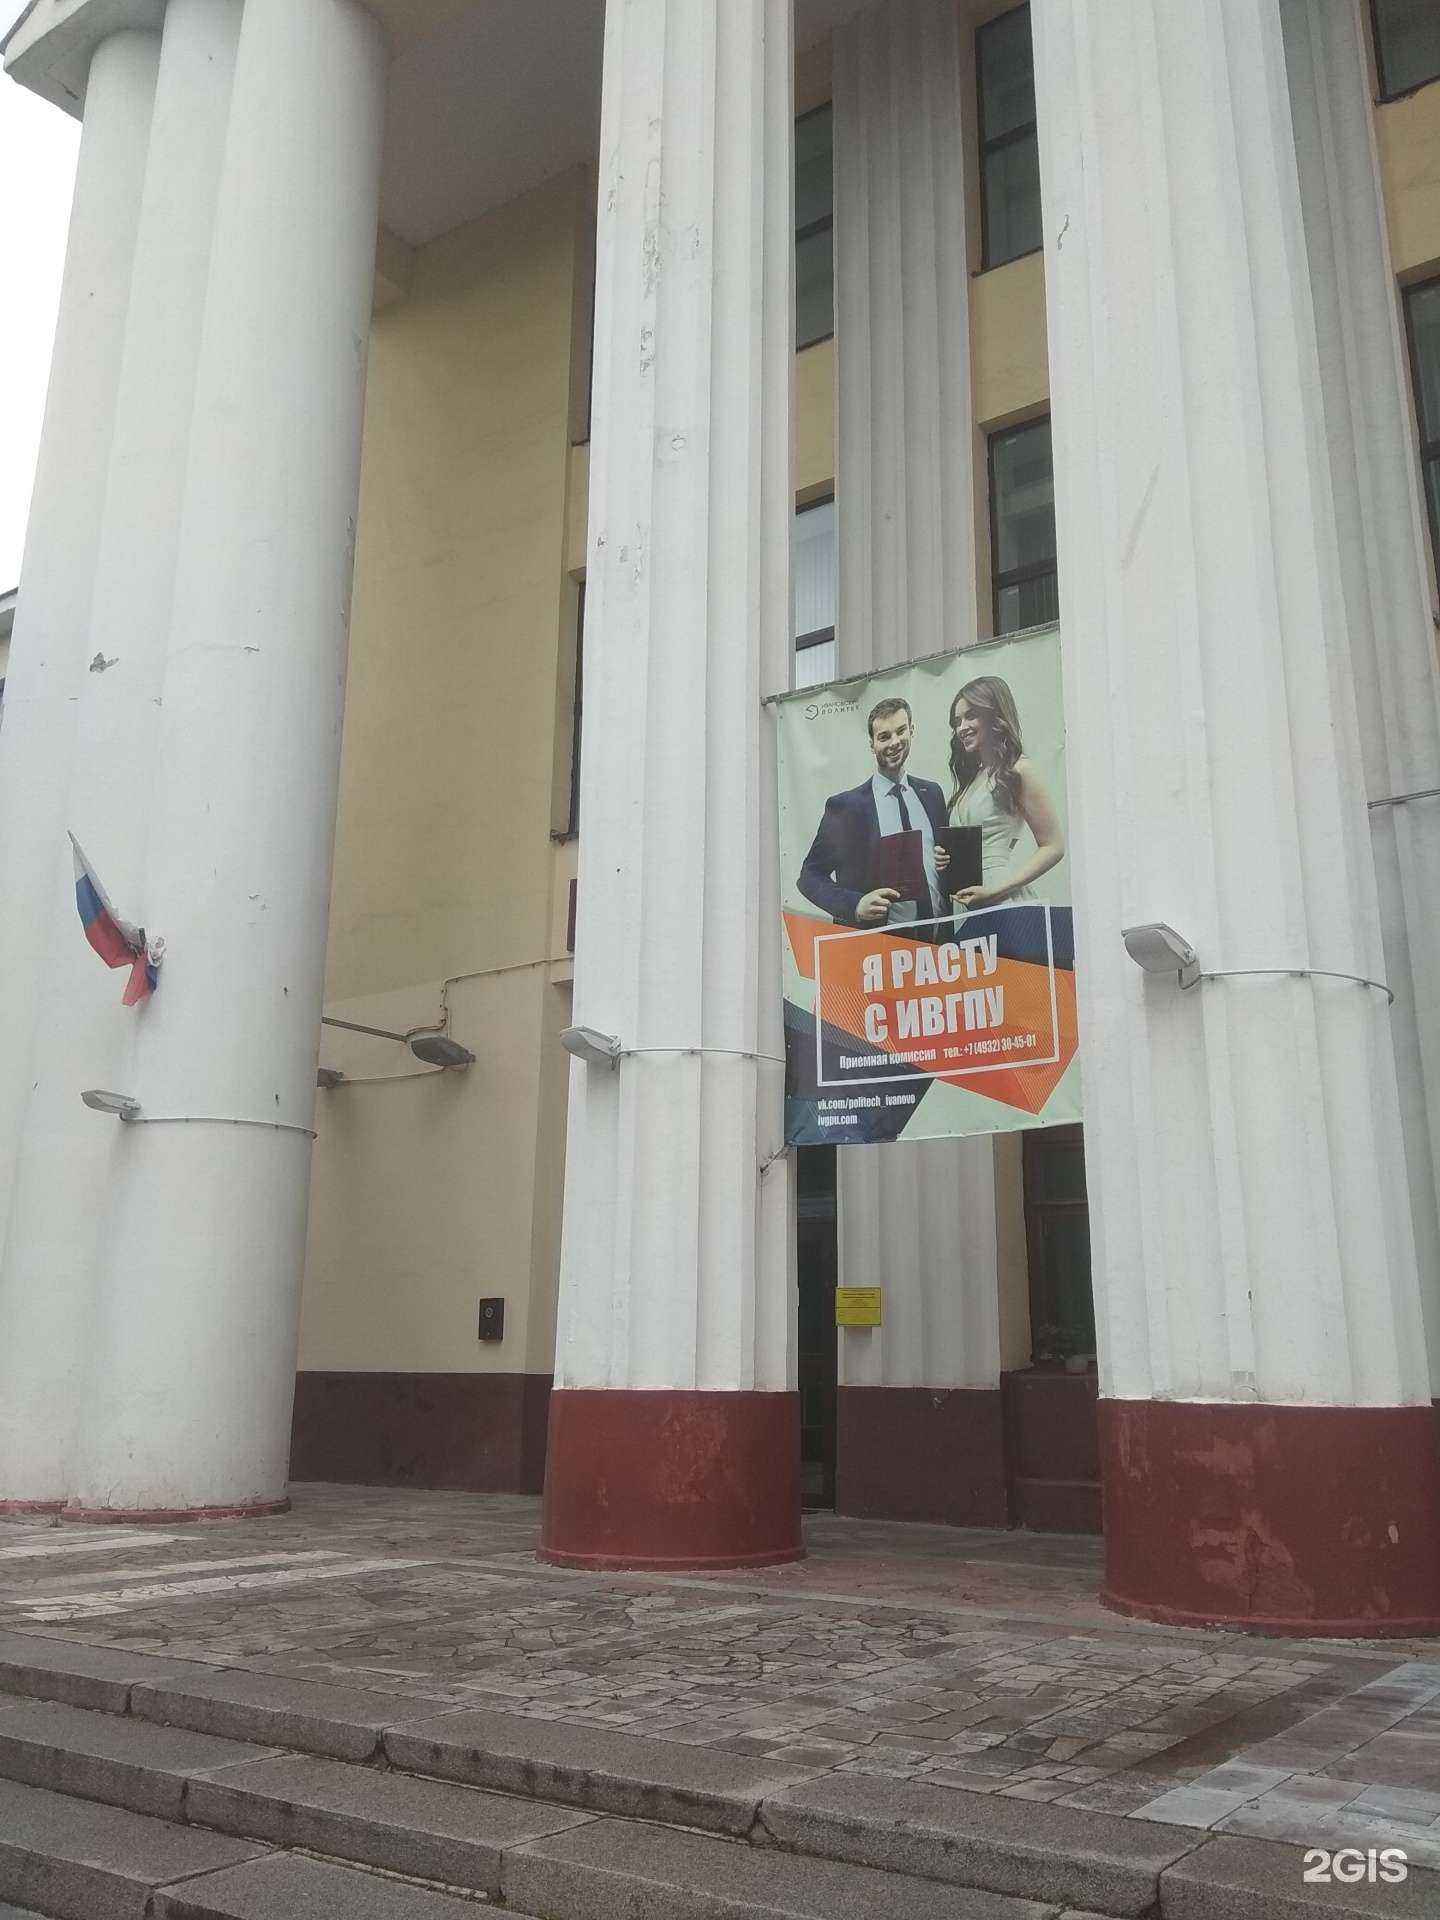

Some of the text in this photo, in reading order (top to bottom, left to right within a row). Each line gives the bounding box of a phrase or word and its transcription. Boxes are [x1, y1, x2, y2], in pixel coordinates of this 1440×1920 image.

[862, 933, 998, 993] Я РАСТУ
[864, 985, 1004, 1043] С ИВГПУ
[839, 1054, 888, 1070] Приемная
[889, 1048, 937, 1065] комиссия
[817, 1094, 916, 1110] vk.com/politech_ivanovo
[817, 1115, 858, 1127] ivgpu.com
